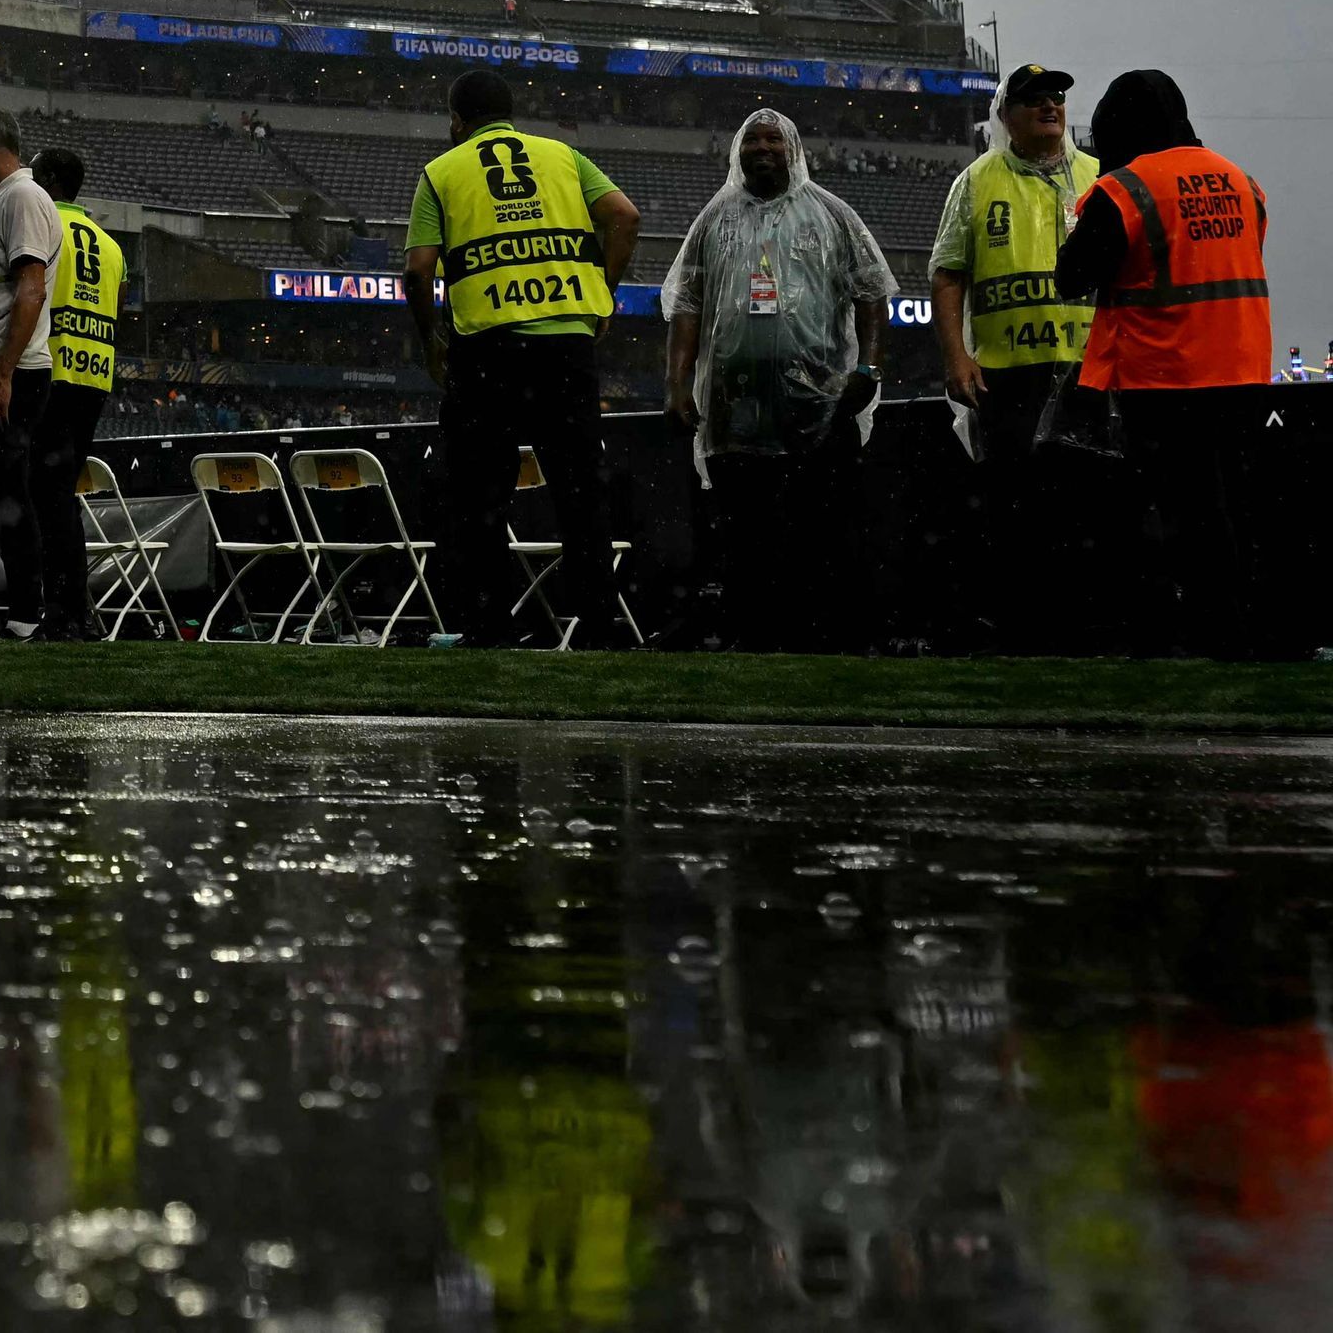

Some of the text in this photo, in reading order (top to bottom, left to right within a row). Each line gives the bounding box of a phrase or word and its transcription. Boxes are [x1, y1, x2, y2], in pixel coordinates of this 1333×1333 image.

[158, 22, 276, 44] PHILADELPHIA
[395, 39, 581, 64] FIFA WORLD CUP 2026
[693, 59, 799, 79] PHILADELPHIA
[502, 184, 526, 195] FIFA
[1177, 173, 1236, 196] APEX
[493, 200, 542, 212] WORLD CUP
[496, 208, 544, 223] 2026
[1178, 195, 1242, 219] SECURITY
[1188, 217, 1244, 241] GROUP
[464, 235, 584, 271] SECURITY
[74, 290, 100, 305] 2026
[275, 273, 445, 302] PHILADELH
[484, 274, 583, 310] 14021
